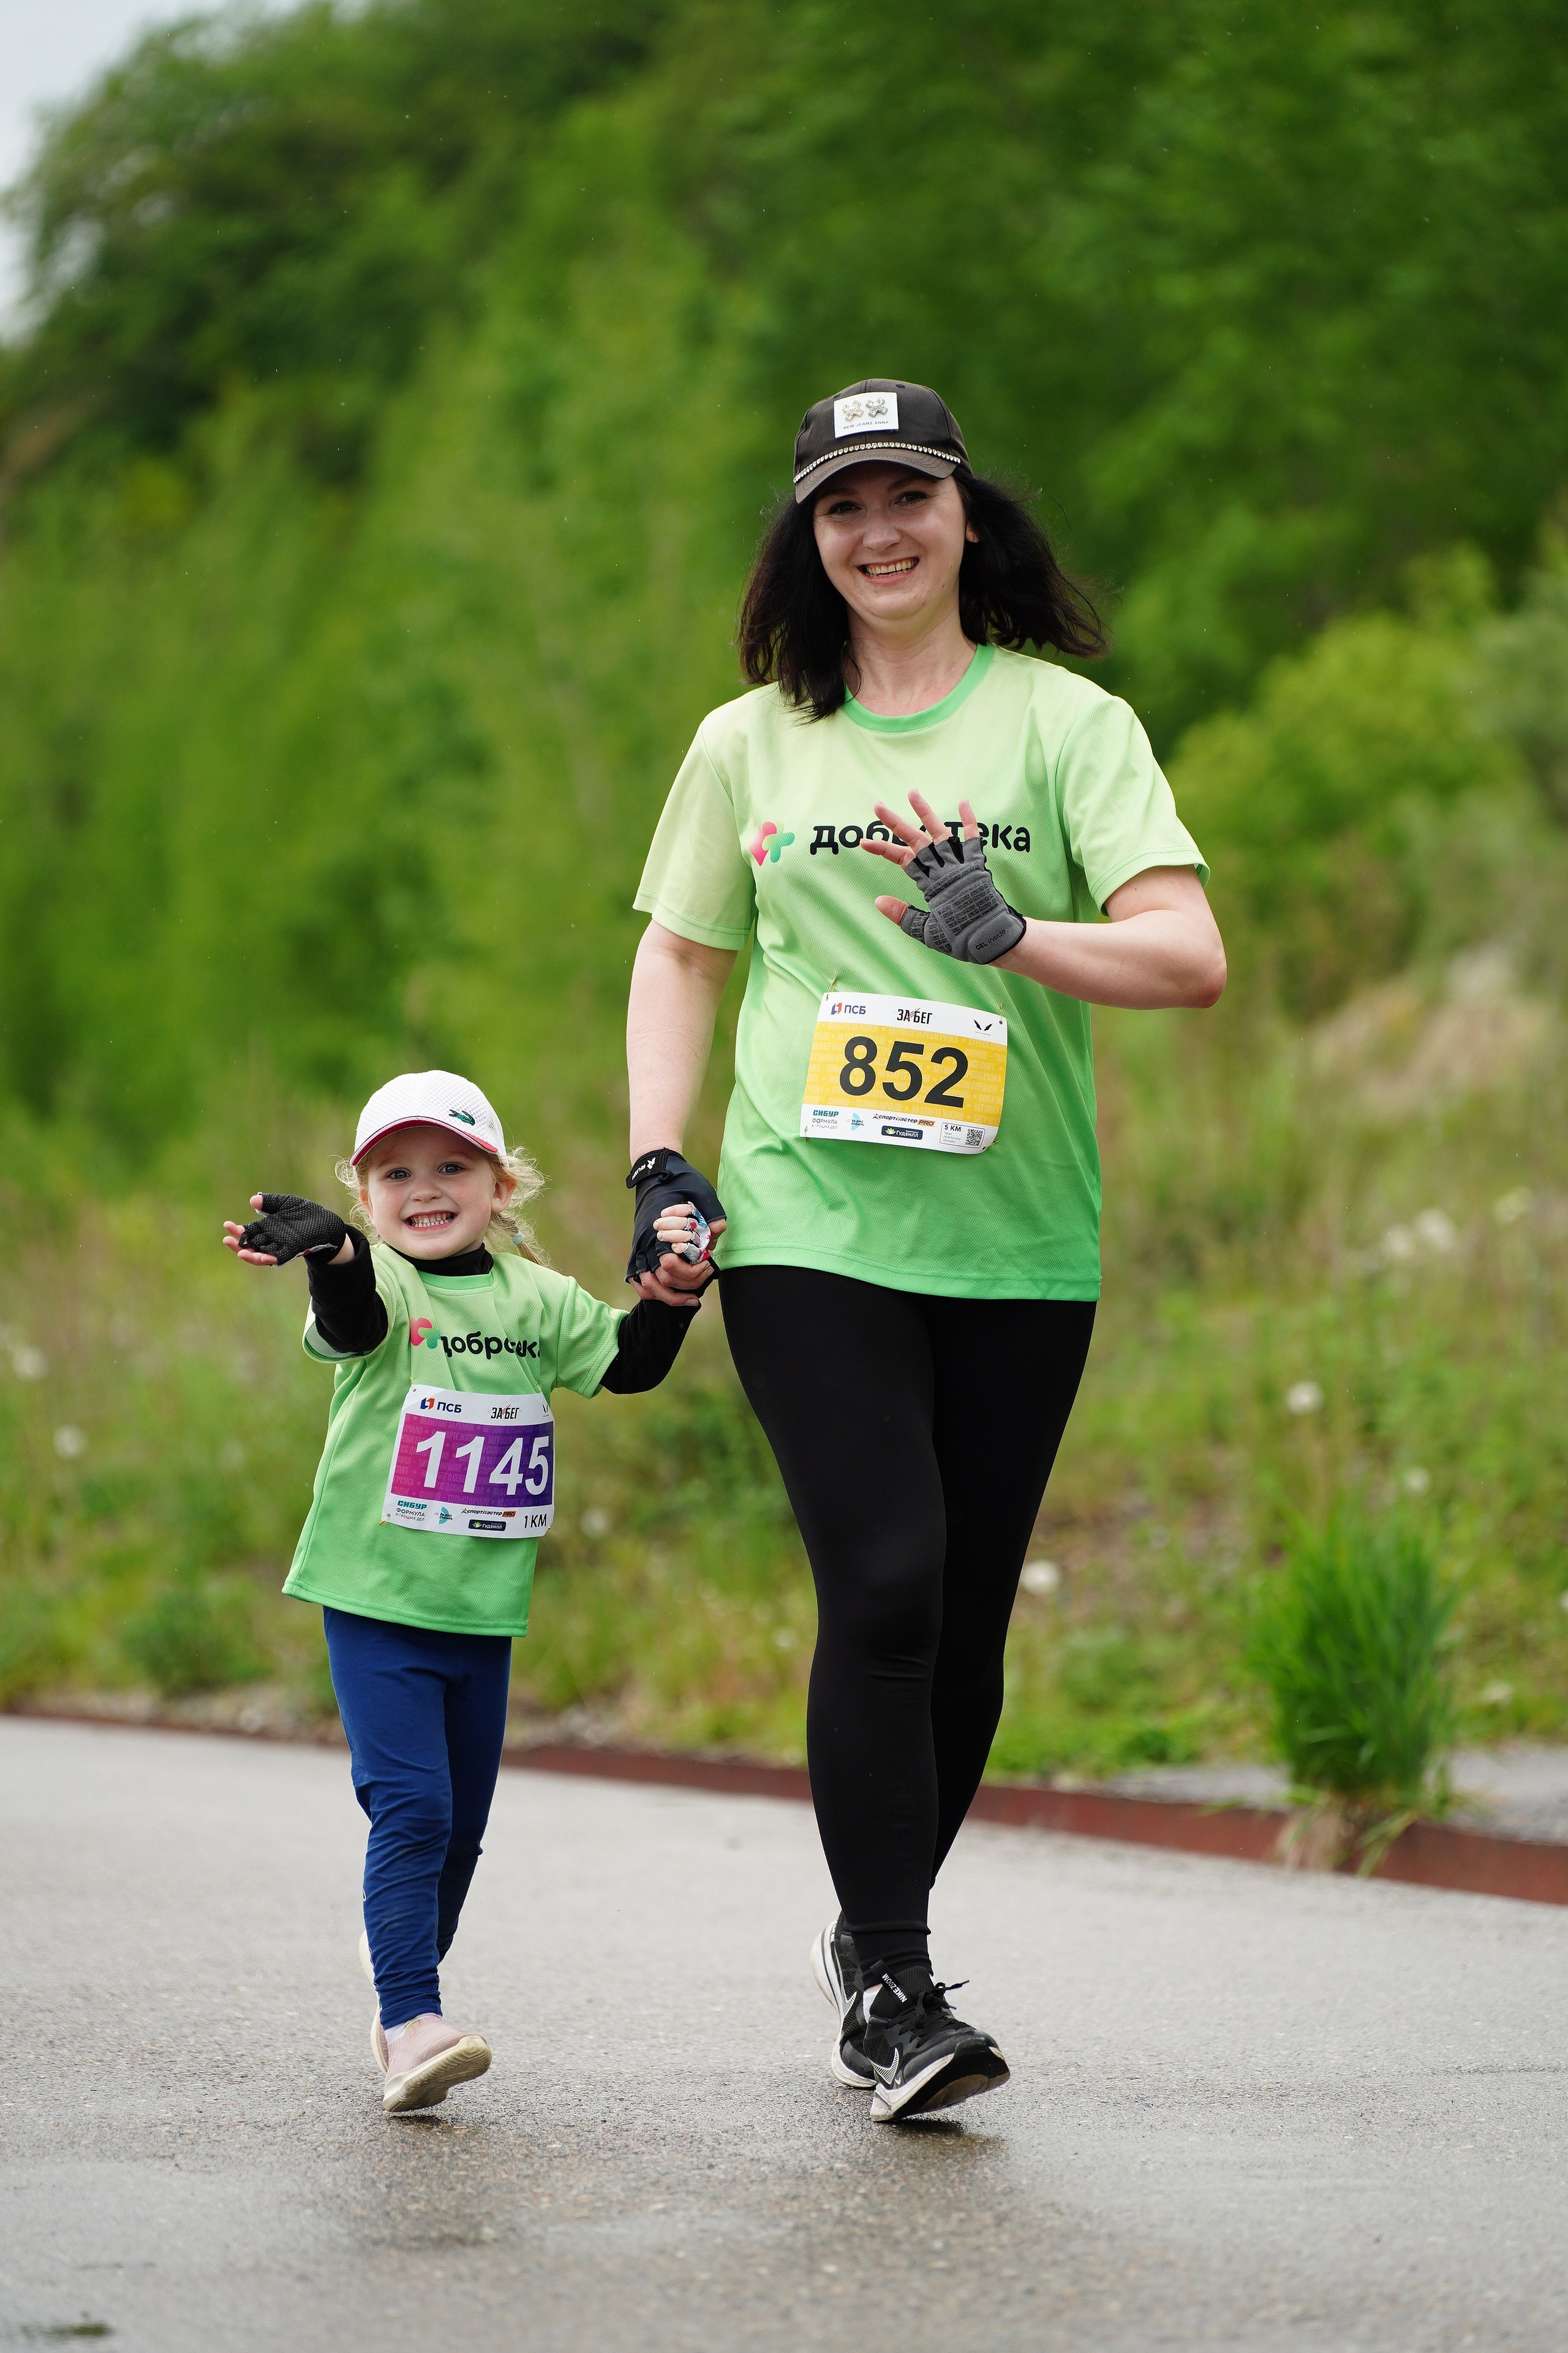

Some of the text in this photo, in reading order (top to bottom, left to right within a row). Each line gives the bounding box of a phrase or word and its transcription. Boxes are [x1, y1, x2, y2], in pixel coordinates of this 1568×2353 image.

[810, 820, 1030, 855] добтека
[975, 929, 1006, 950] GEL inside
[844, 1005, 866, 1014] ПСБ
[839, 1036, 968, 1108] 852
[437, 1402, 462, 1413] ПСБ
[416, 1431, 549, 1495] 1145
[398, 1500, 427, 1510] СИБУР
[396, 1508, 425, 1517] ФОРМУЛА
[524, 1515, 529, 1528] 1
